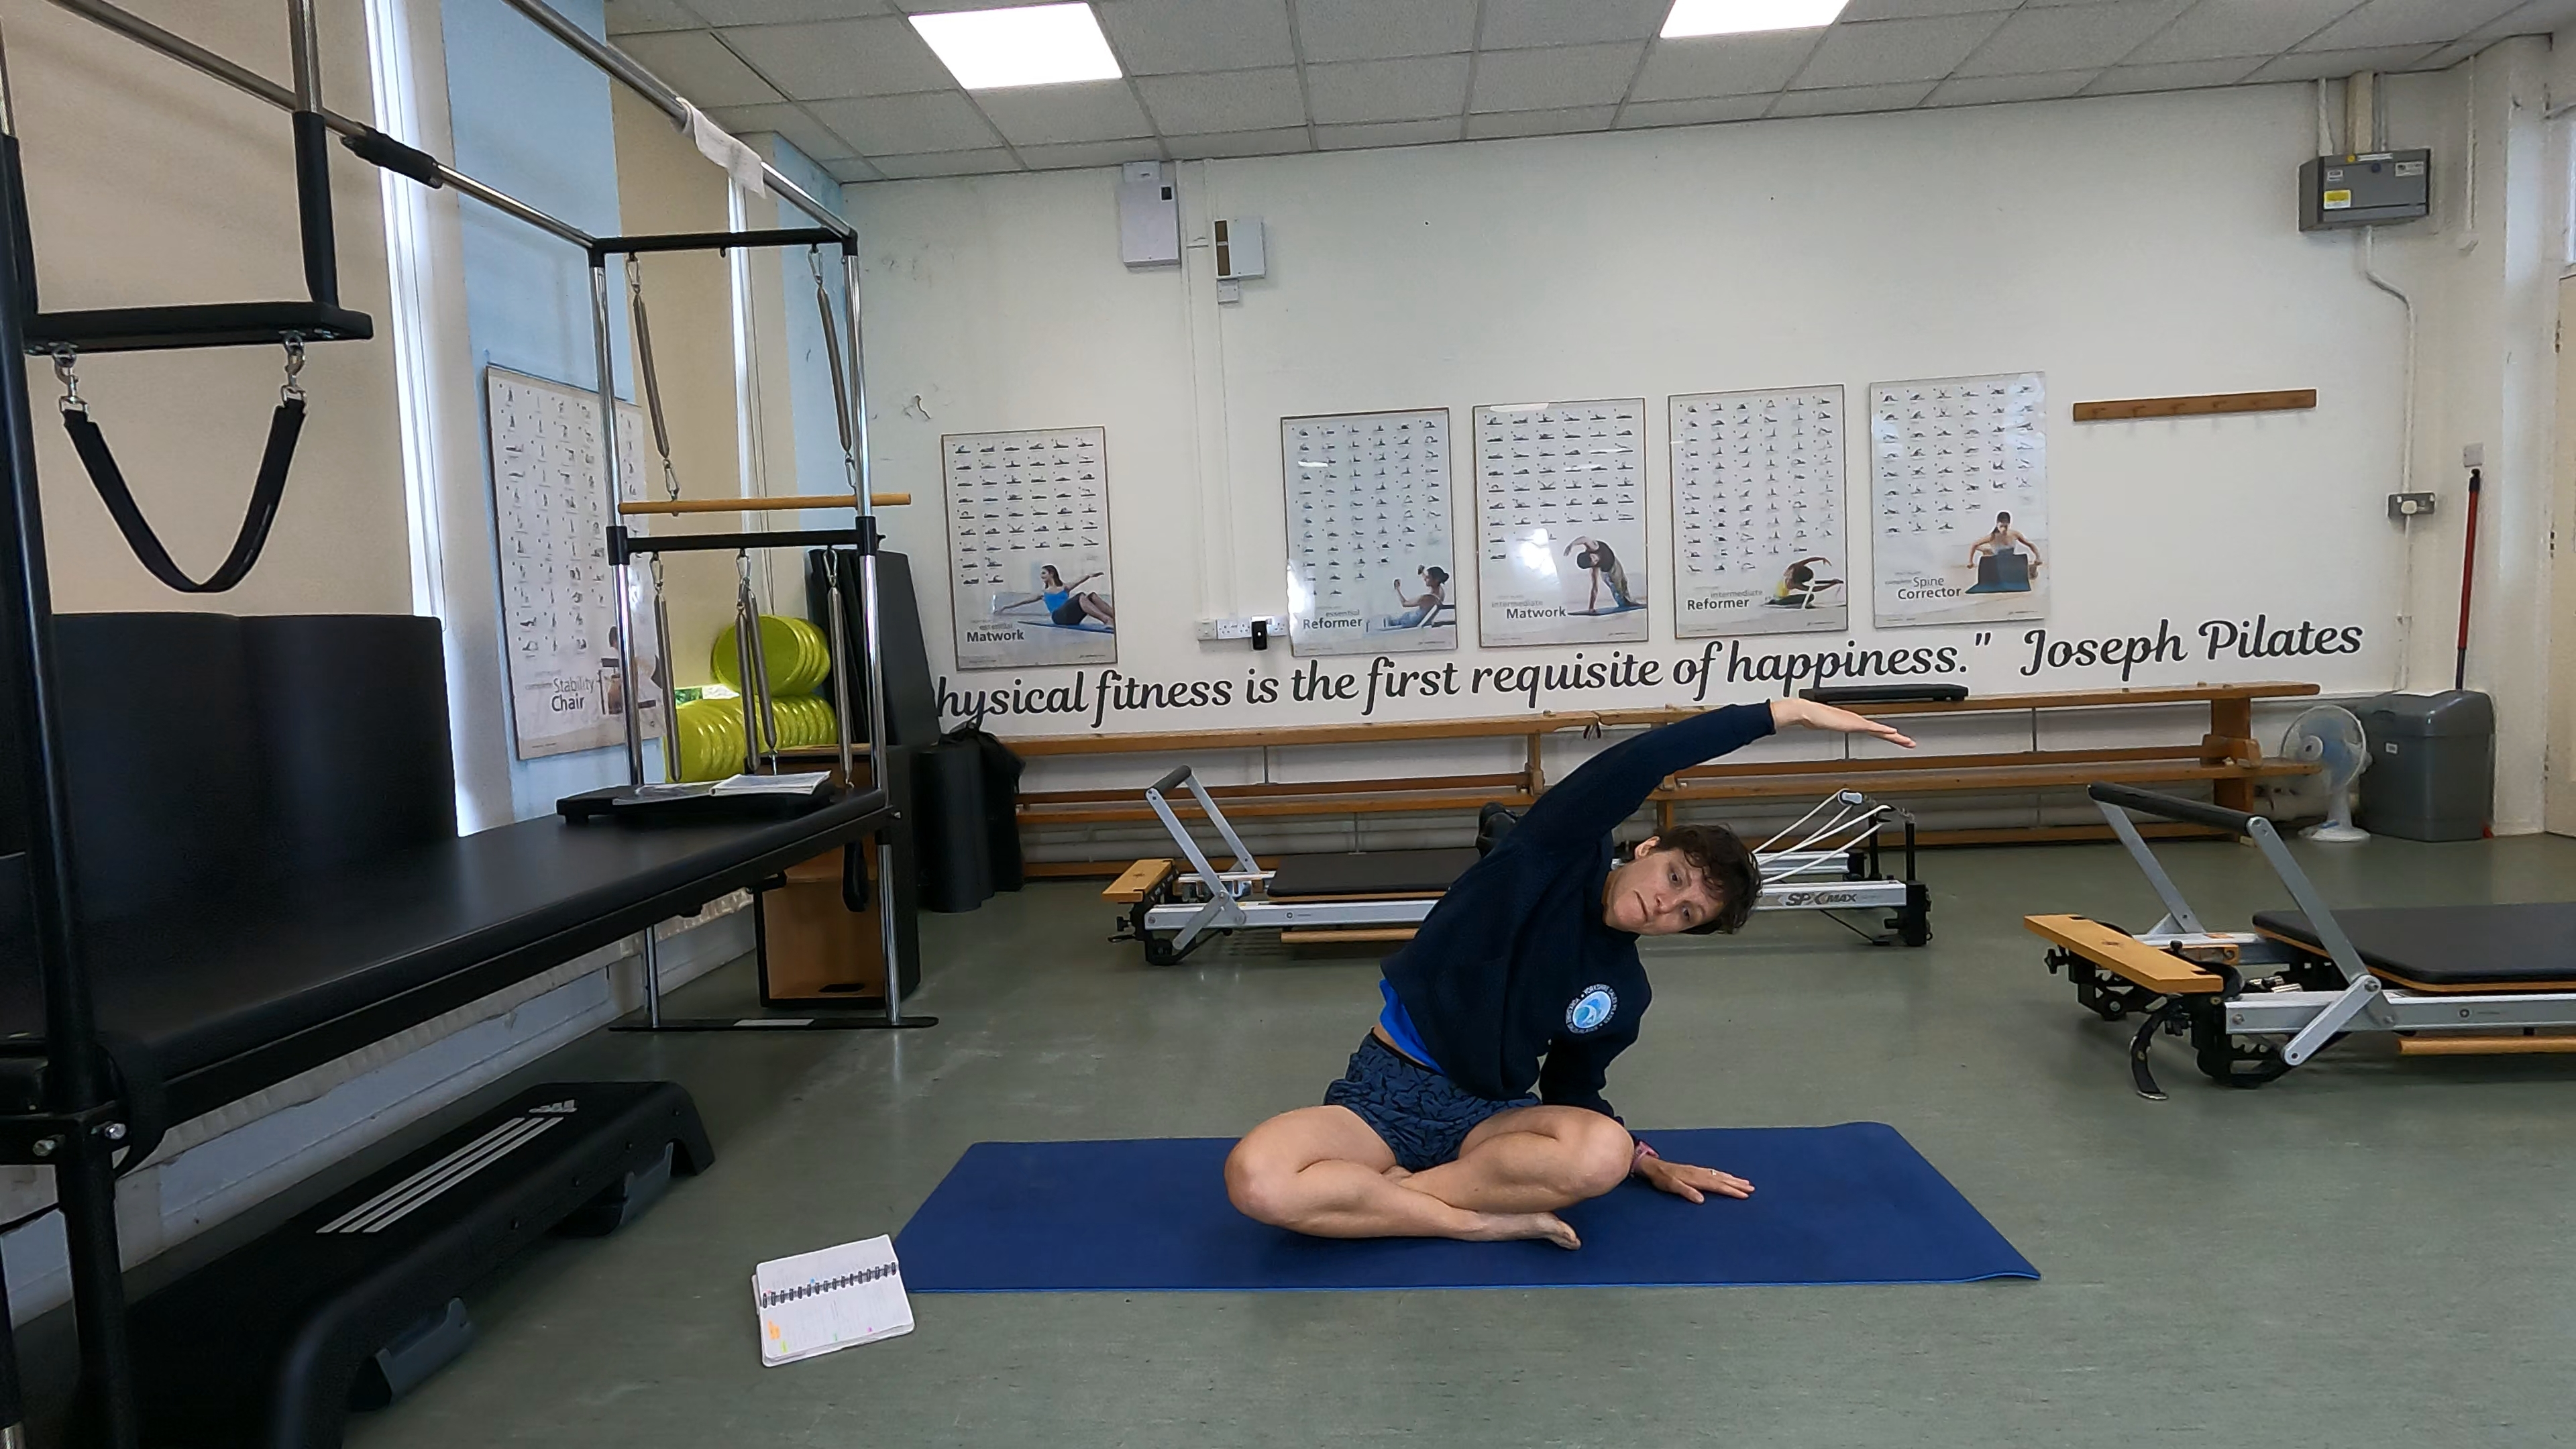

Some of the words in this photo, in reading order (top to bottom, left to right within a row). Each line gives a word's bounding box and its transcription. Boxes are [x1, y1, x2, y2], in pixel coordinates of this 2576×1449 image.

[1913, 576, 1944, 588] Spine
[1897, 588, 1962, 599] Corrector
[1687, 598, 1750, 610] Reformer
[1506, 606, 1566, 619] Matwork
[1303, 617, 1362, 629] Reformer
[967, 629, 1025, 642] Matwork
[936, 671, 1089, 730] hysical
[1091, 669, 1232, 728] fitness
[1246, 668, 1279, 704] is
[1291, 659, 1358, 702] the
[1361, 655, 1460, 716] first
[1472, 651, 1664, 708] requisite
[1673, 640, 1722, 702] of
[1727, 632, 1992, 698] happiness."
[2020, 619, 2188, 682] Joseph
[2198, 613, 2363, 660] Pilates
[553, 676, 594, 694] Stability
[551, 693, 585, 712] Chair
